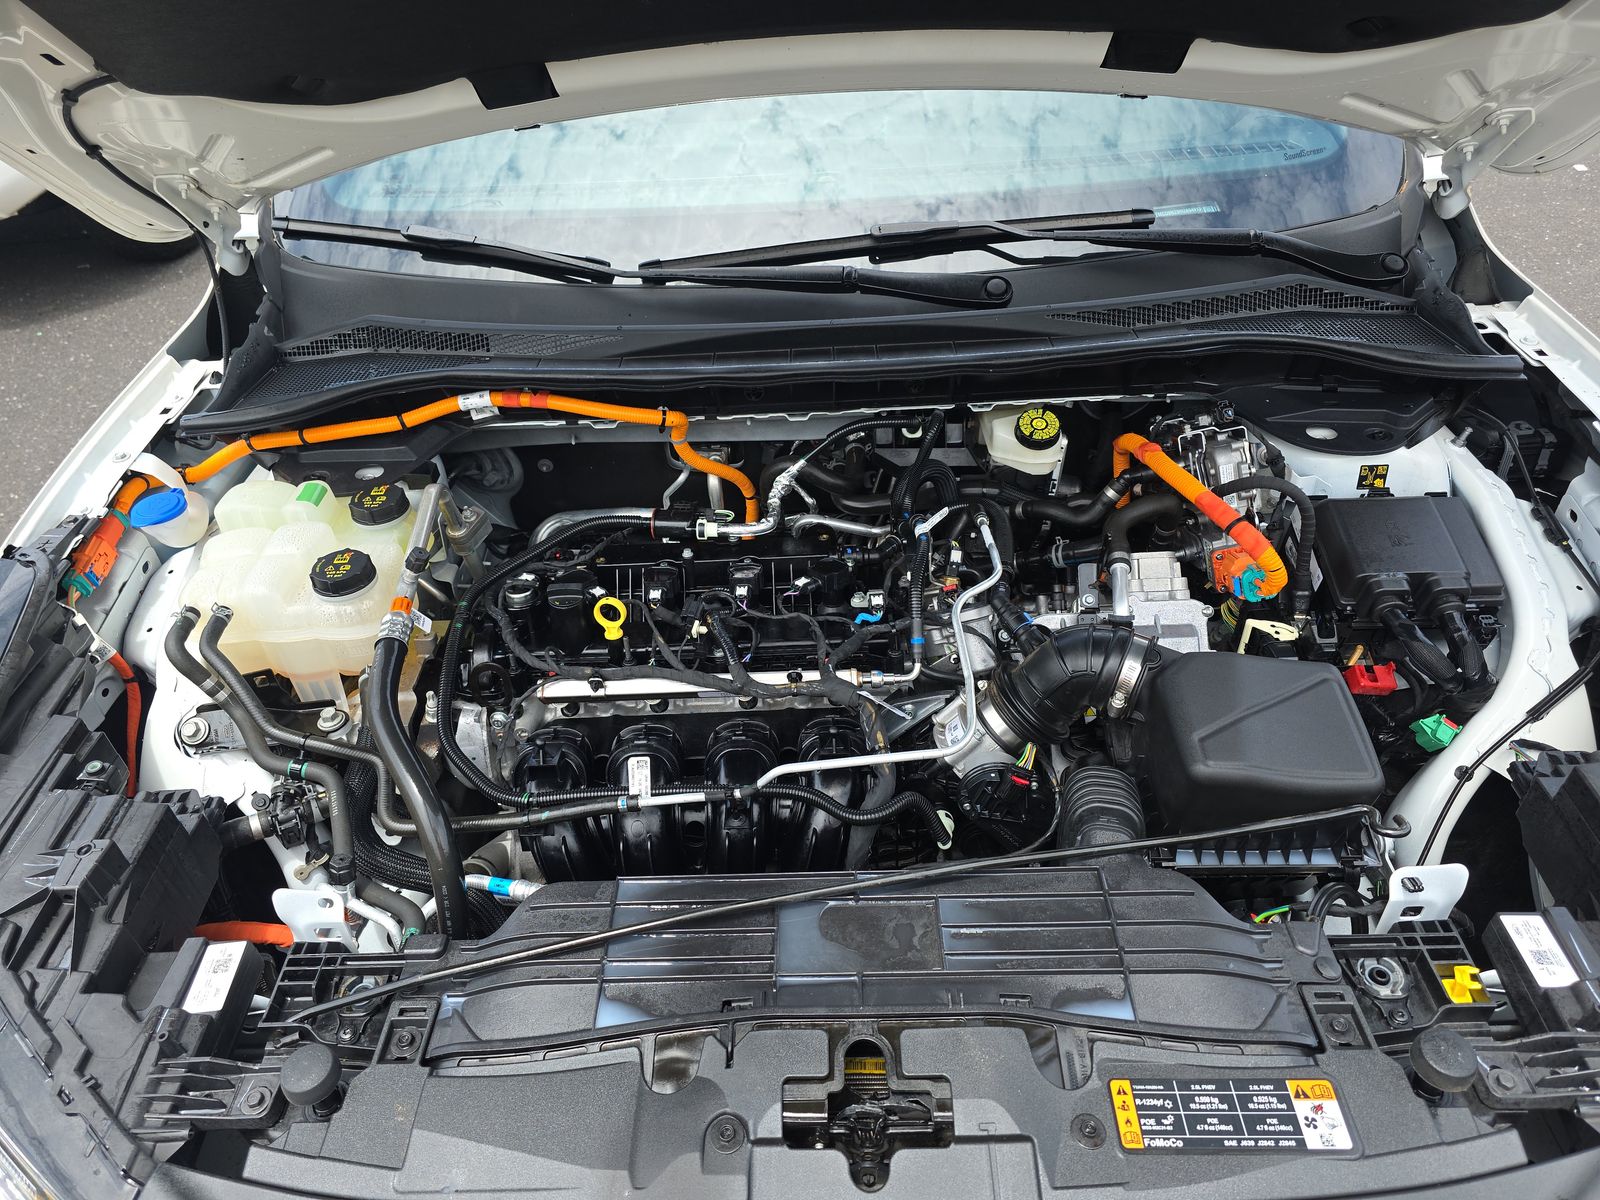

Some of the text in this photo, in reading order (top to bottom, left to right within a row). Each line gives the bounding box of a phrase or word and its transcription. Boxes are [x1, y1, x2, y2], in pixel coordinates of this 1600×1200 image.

[1135, 1098, 1163, 1107] R-1234yf
[1269, 1096, 1278, 1104] kg
[1143, 1138, 1184, 1148] FoMoCo
